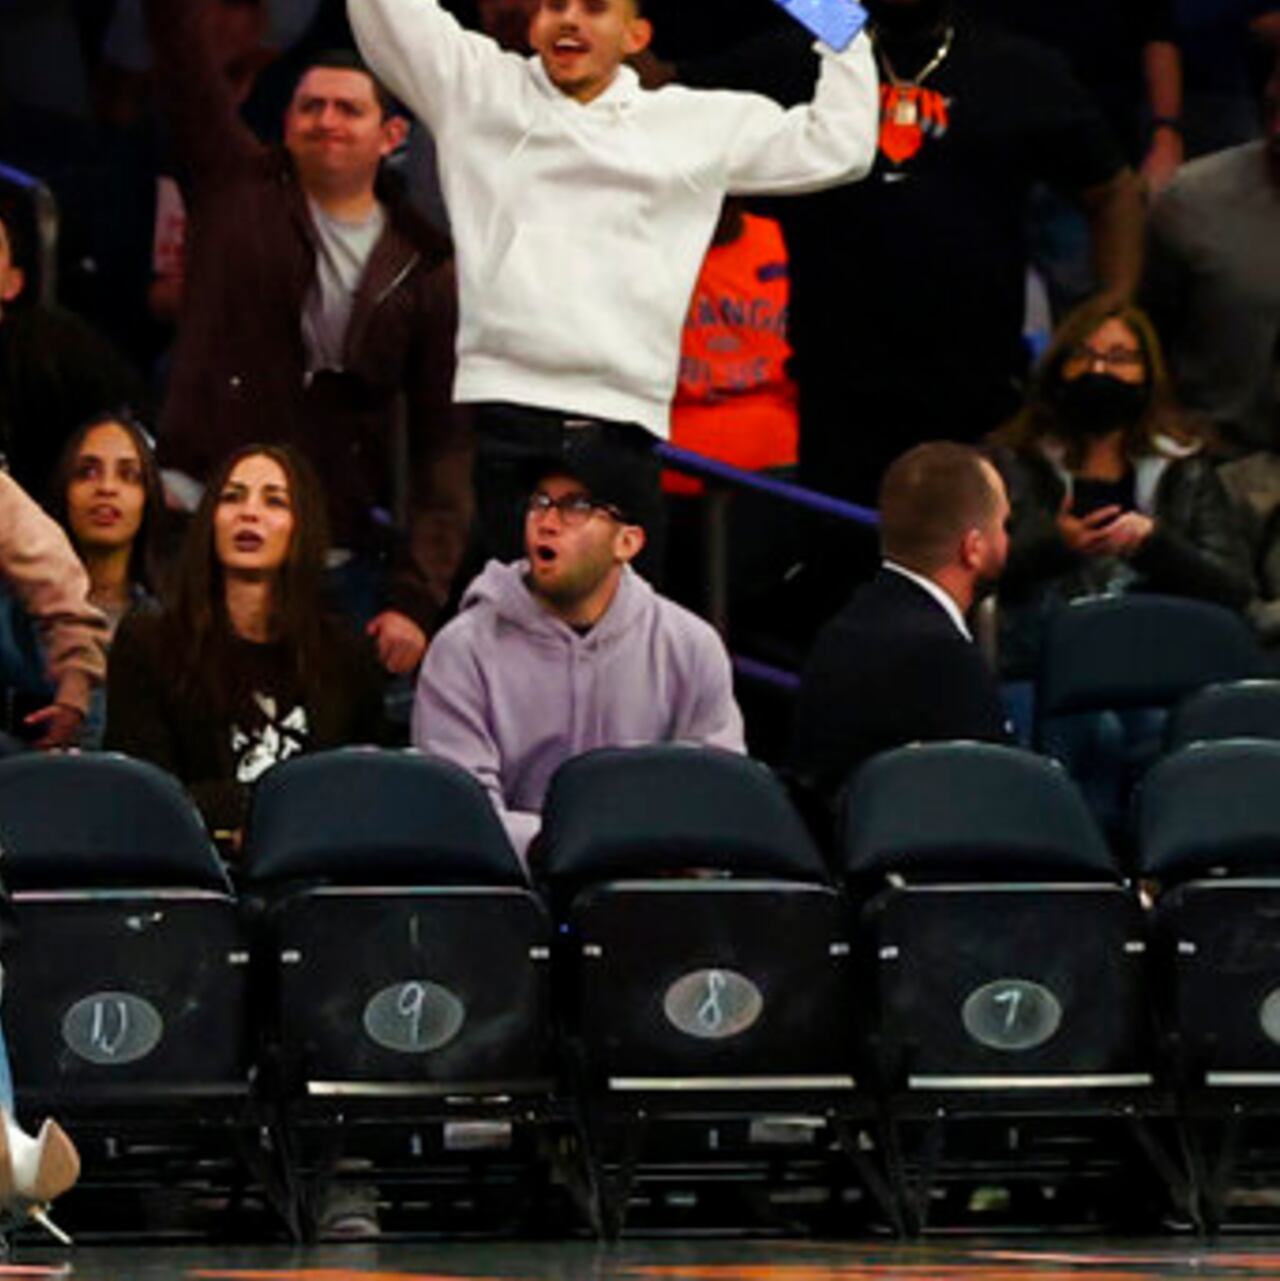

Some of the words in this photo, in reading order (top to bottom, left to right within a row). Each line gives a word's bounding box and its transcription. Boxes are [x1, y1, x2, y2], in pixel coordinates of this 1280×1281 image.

[398, 983, 425, 1044] 9
[697, 970, 726, 1029] 8
[993, 989, 1022, 1032] 7
